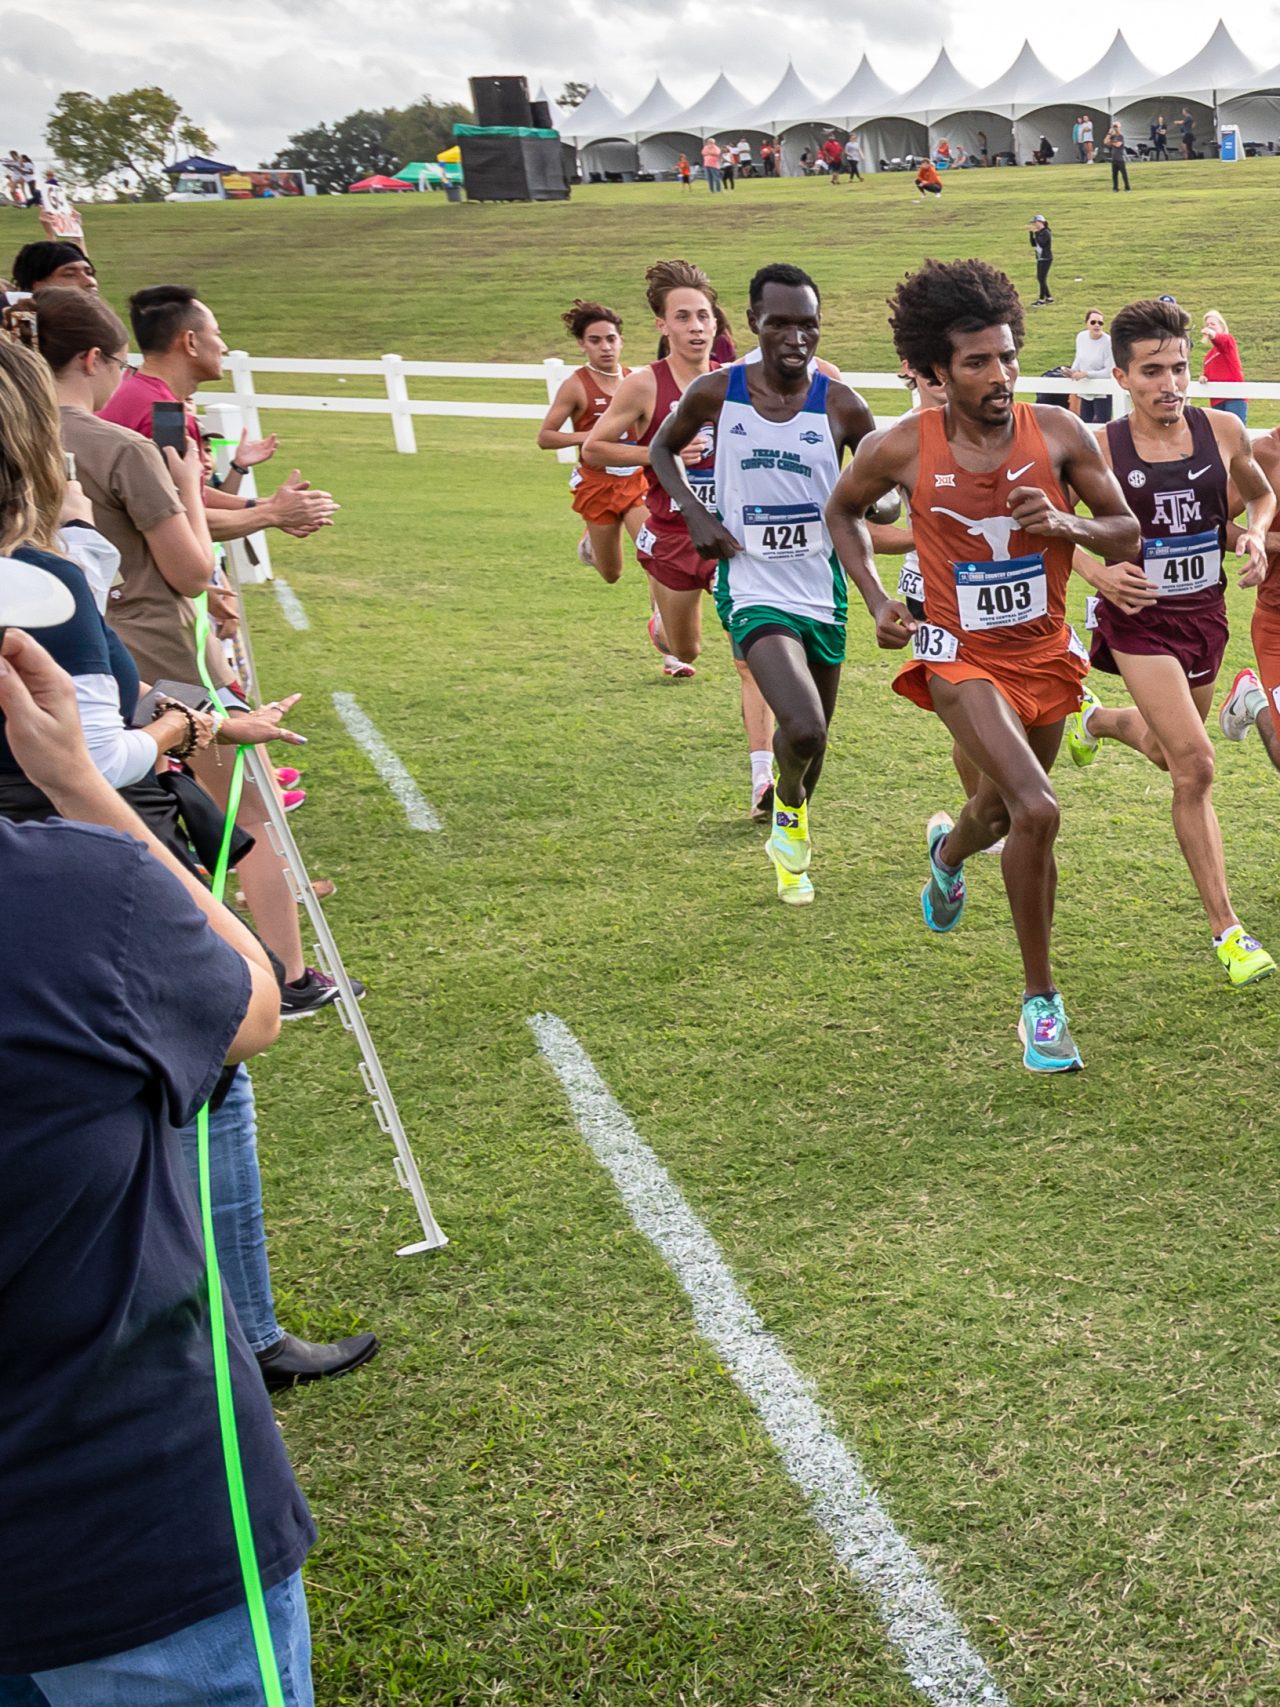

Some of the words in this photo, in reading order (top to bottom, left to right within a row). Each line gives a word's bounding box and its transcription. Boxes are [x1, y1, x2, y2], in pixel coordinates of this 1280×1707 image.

[741, 458, 775, 470] CORPUS
[752, 449, 780, 458] TEXAS
[762, 524, 808, 550] 424
[1163, 555, 1205, 583] 410
[977, 581, 1032, 615] 403
